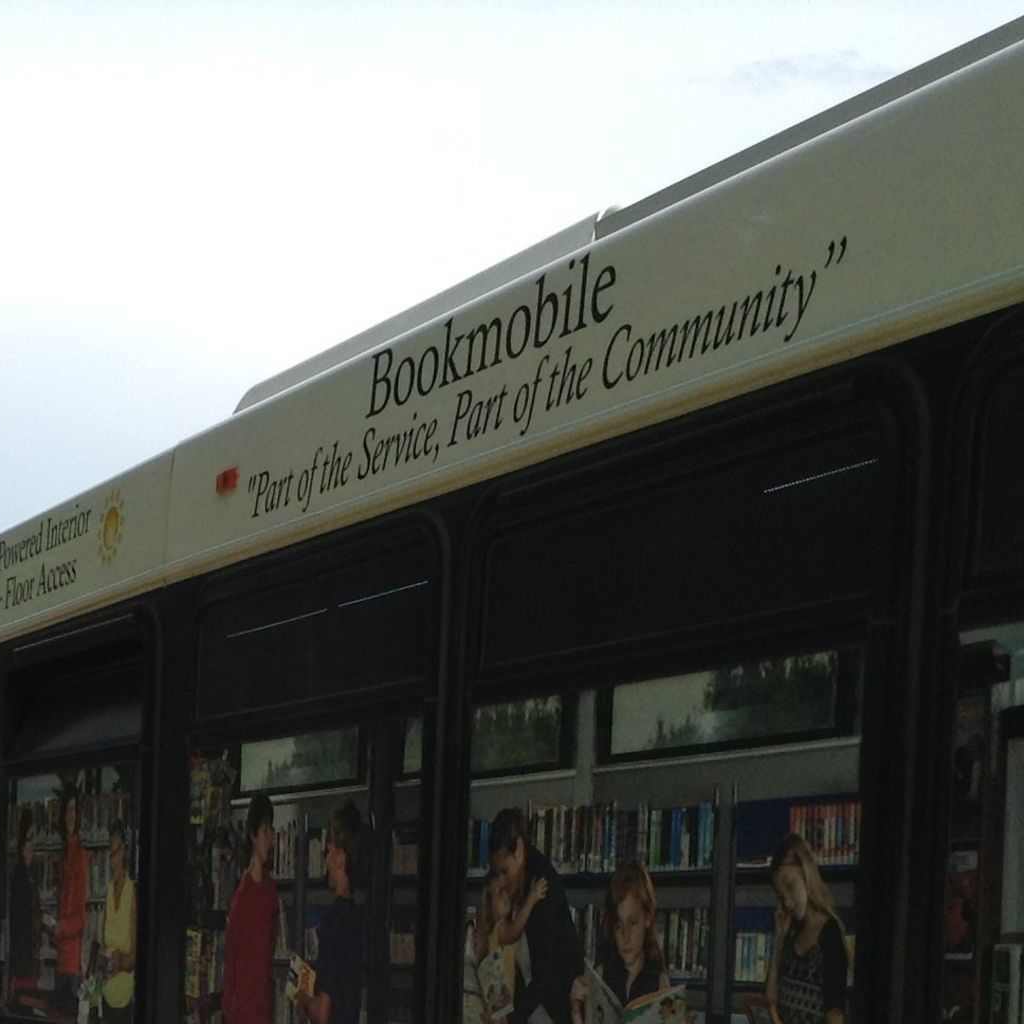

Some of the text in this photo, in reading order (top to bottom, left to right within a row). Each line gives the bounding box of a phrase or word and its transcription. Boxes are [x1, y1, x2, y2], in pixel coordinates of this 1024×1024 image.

[365, 252, 617, 419] Bookmobile
[296, 447, 325, 512] of
[321, 440, 353, 493] the
[356, 413, 440, 480] Service,
[447, 388, 506, 447] Part
[513, 354, 549, 436] of
[547, 346, 593, 408] the
[36, 559, 78, 597] Access
[46, 503, 92, 551] Interior
